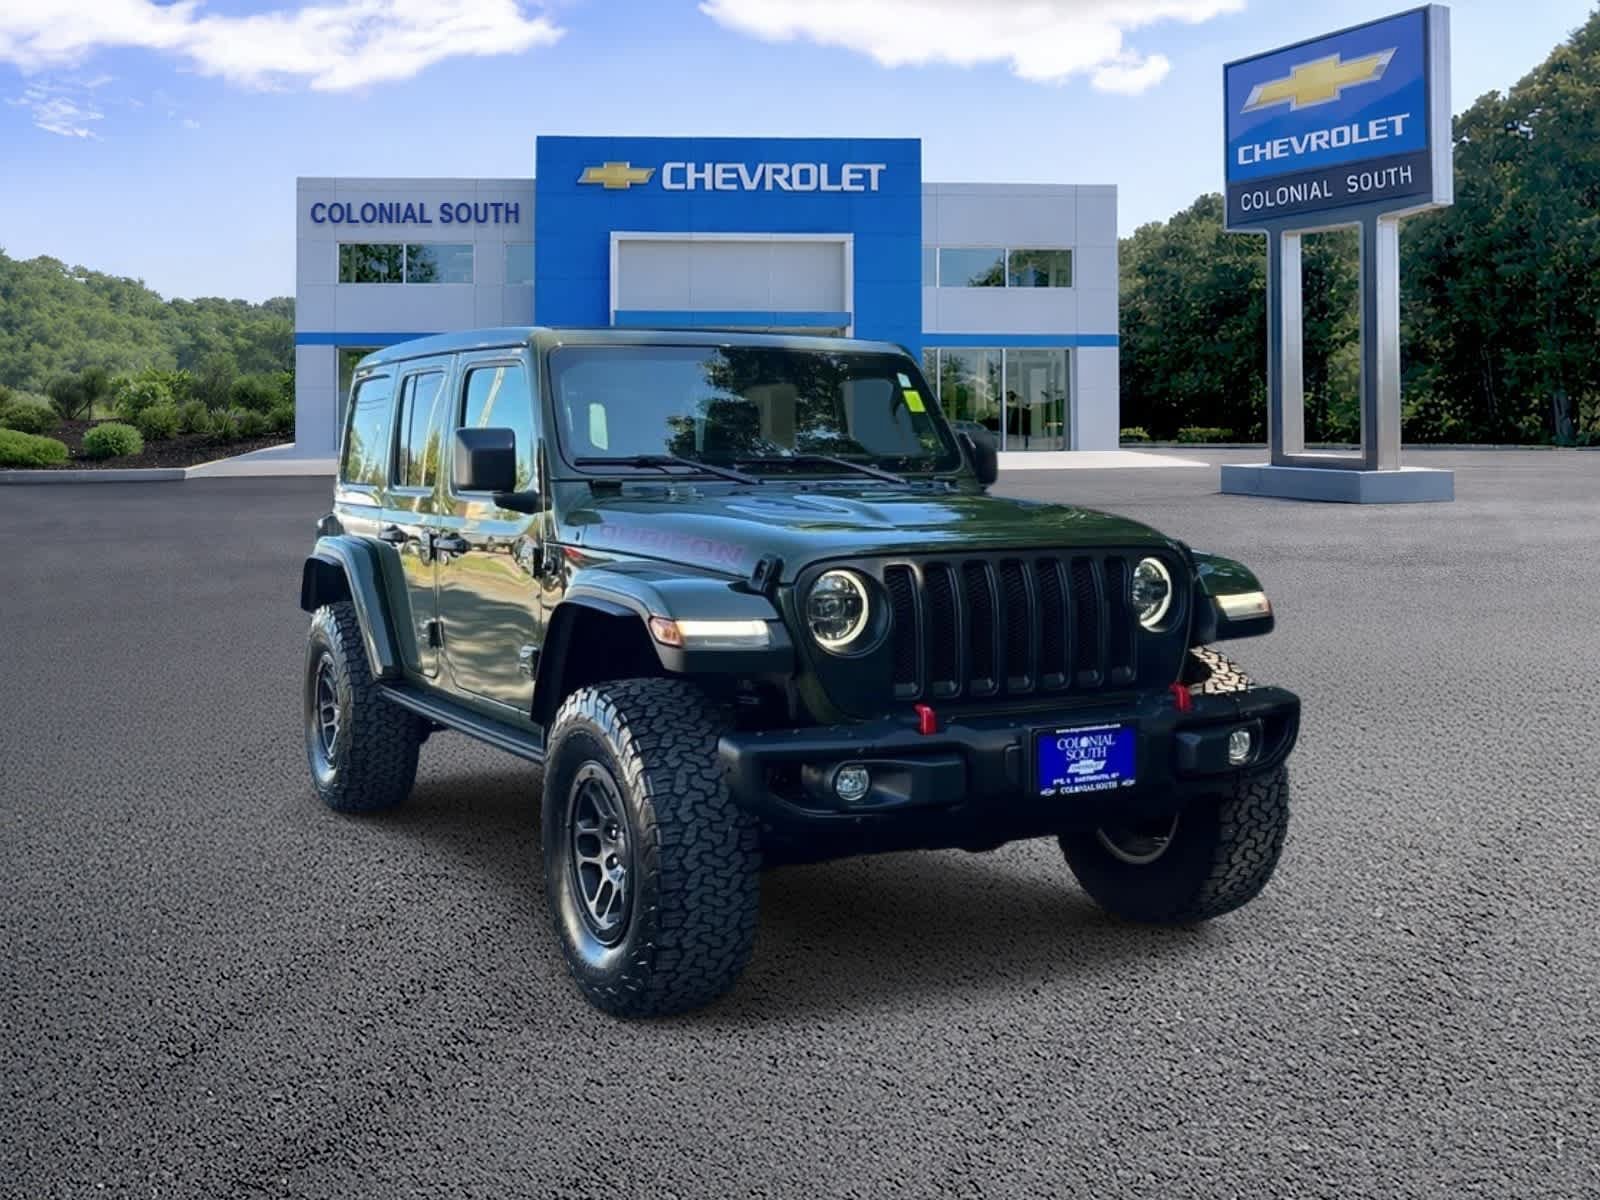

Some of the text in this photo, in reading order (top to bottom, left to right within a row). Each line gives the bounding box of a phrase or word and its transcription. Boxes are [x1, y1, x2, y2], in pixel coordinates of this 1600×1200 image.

[1238, 113, 1410, 165] CHEVROLET
[661, 162, 886, 193] CHEVROLET
[1240, 165, 1413, 211] COLONIAL SOUTH
[310, 202, 521, 225] COLONIAL SOUTH
[1056, 734, 1116, 751] COLONIAL
[1065, 746, 1107, 761] SOUTH
[1060, 781, 1118, 795] COLONIAL SOUTH
